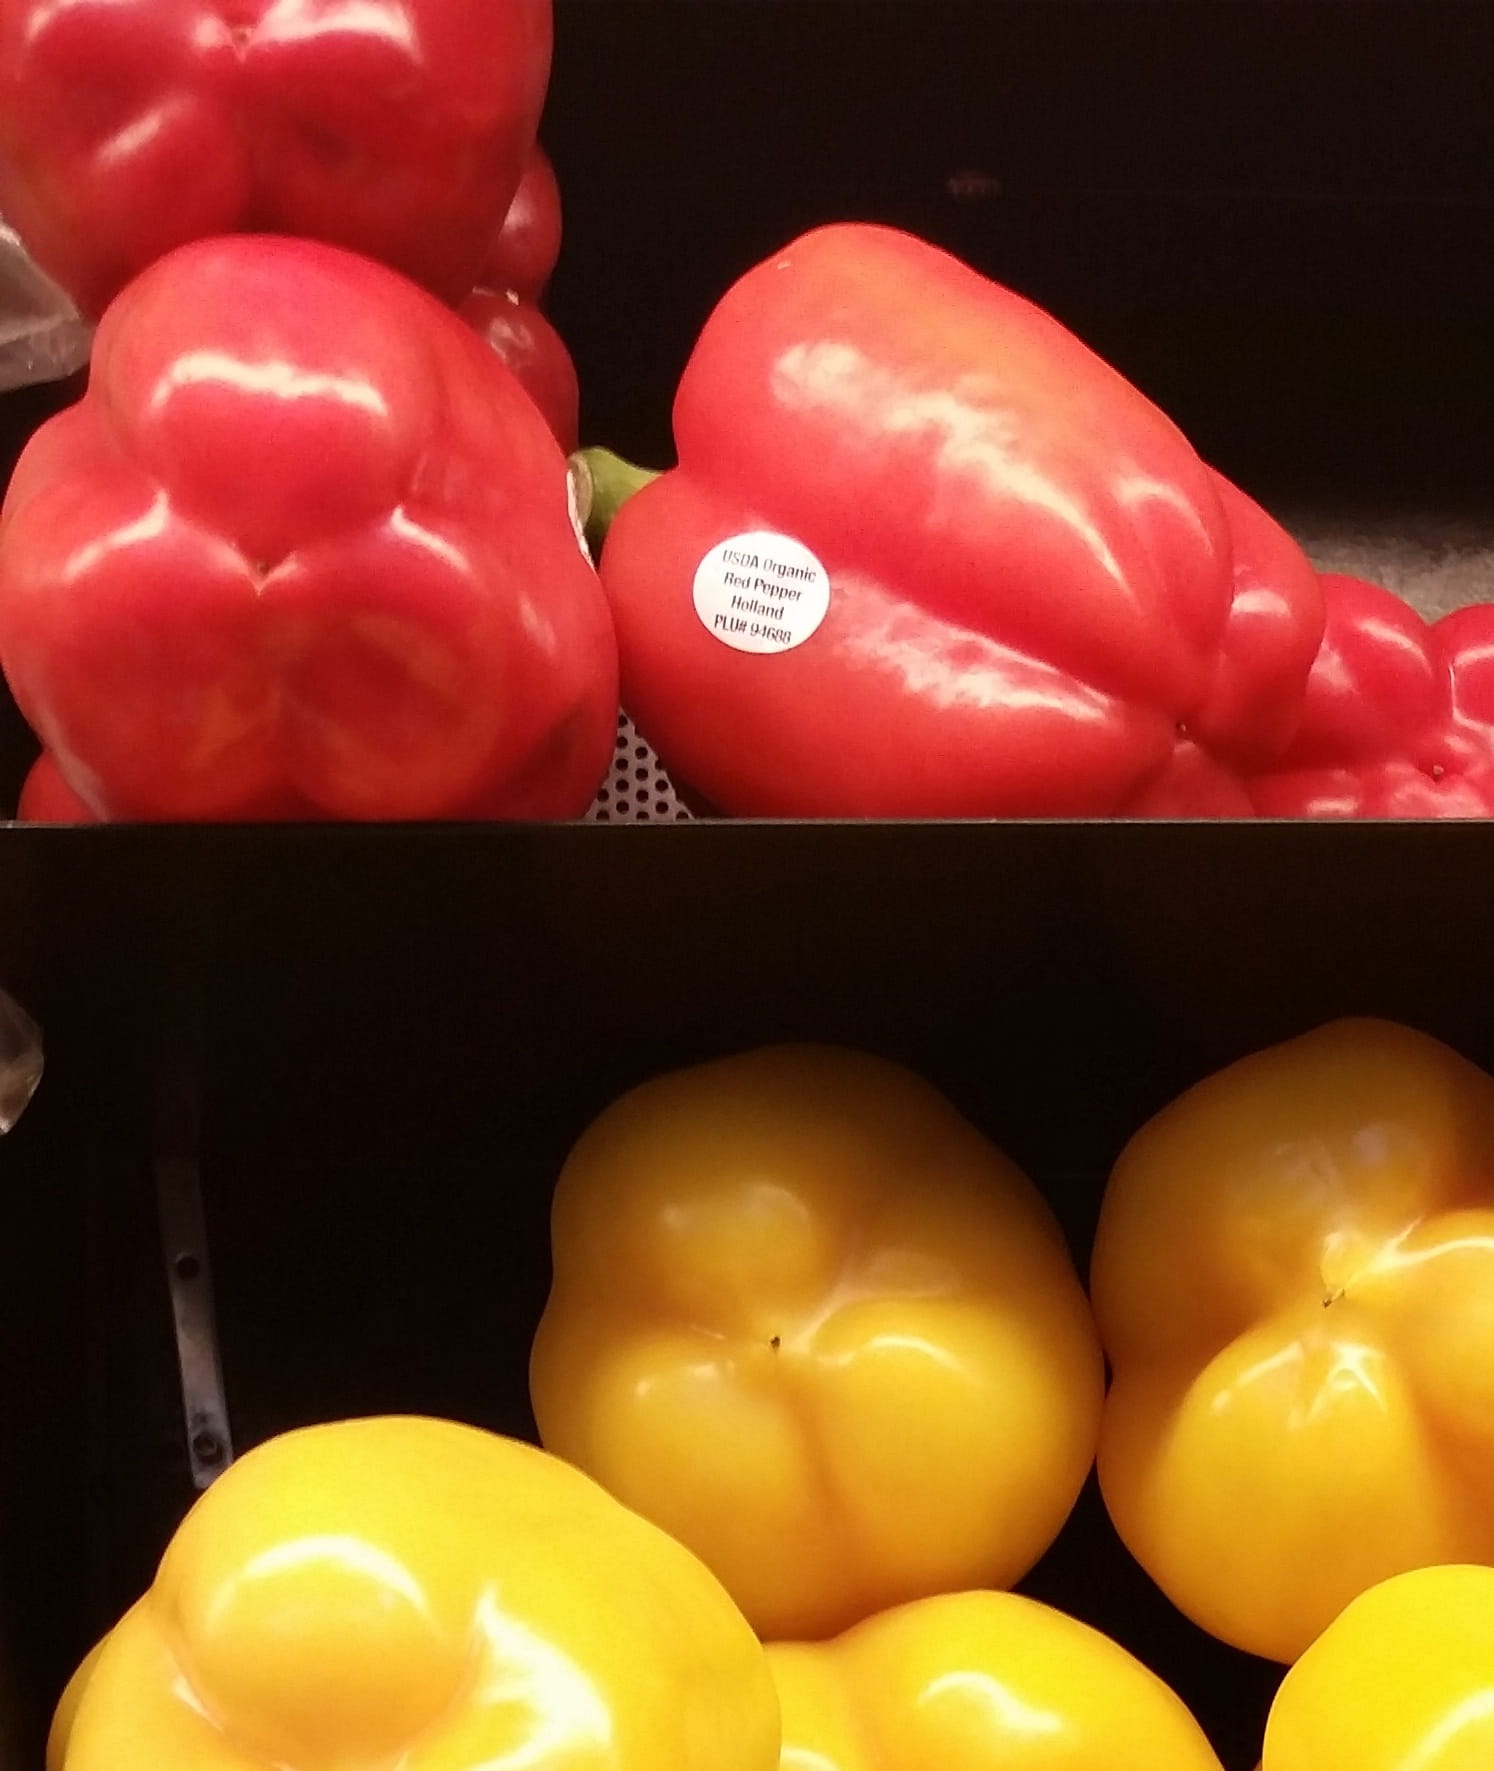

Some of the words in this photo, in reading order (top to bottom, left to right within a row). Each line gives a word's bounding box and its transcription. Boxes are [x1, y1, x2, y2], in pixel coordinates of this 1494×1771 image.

[722, 549, 759, 569] USDA
[763, 558, 817, 583] Organic
[723, 571, 751, 589] Red
[753, 578, 803, 602] Pepper
[731, 595, 784, 621] Holland
[713, 613, 747, 635] PLU#
[750, 624, 792, 645] 94688
